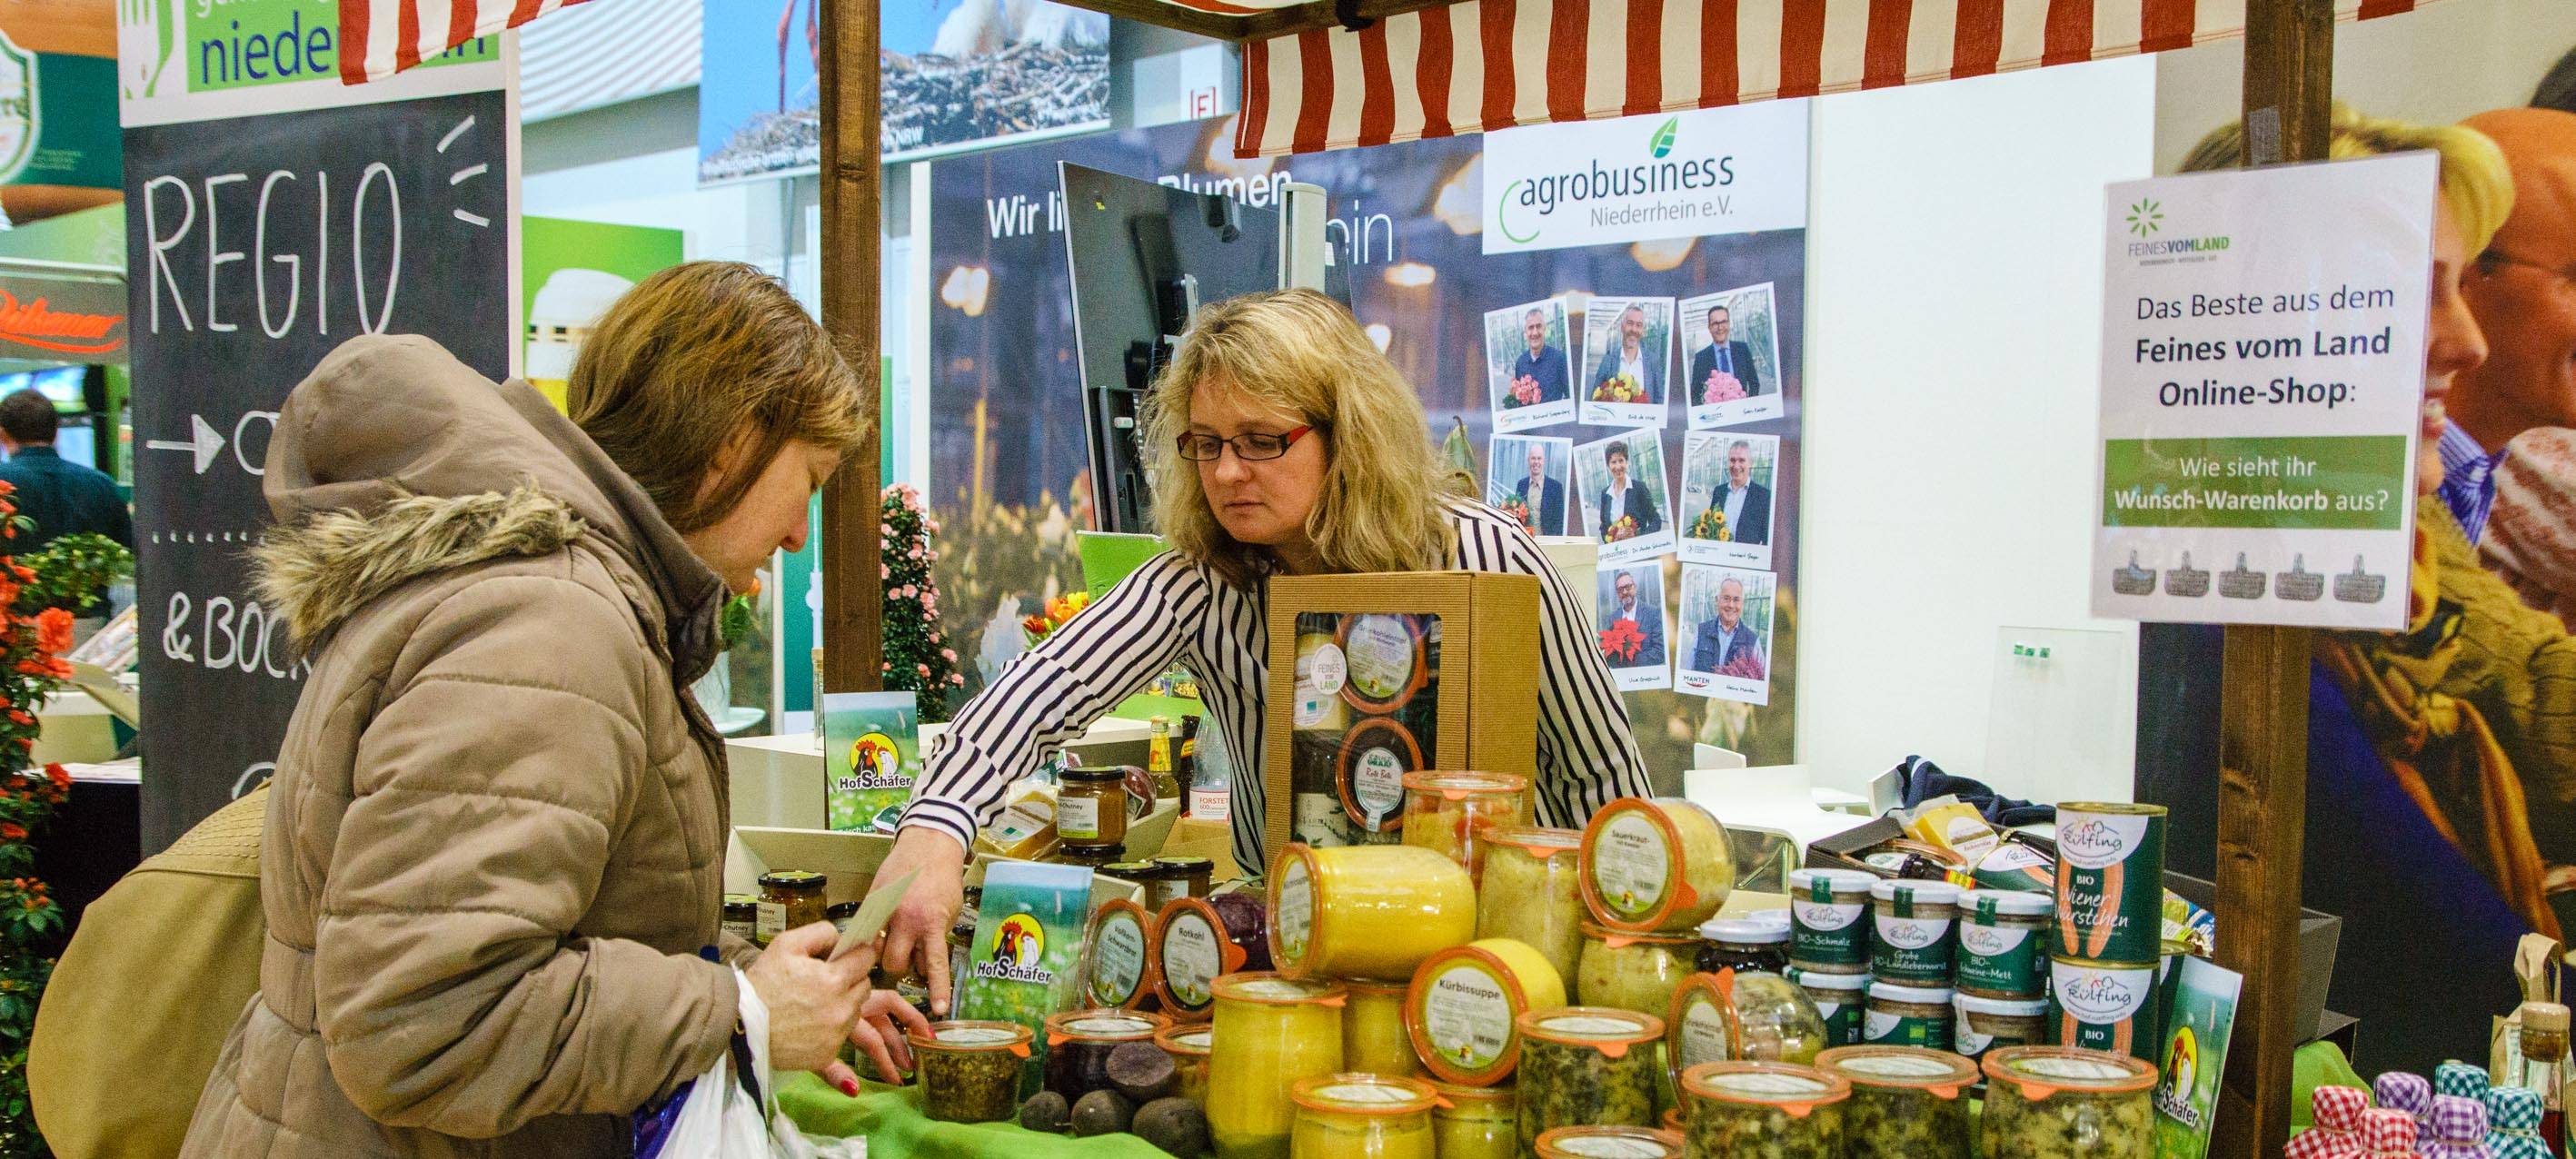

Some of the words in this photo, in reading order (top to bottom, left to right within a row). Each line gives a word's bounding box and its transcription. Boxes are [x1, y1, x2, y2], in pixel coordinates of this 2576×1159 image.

[201, 10, 340, 84] niede
[1519, 155, 1735, 215] agrobusiness
[987, 194, 1039, 239] Wir
[1590, 199, 1696, 227] Niederrhein
[1701, 194, 1733, 217] e.V.
[144, 162, 402, 339] REGIO
[2128, 236, 2230, 256] FEINESVOMLAND
[2136, 296, 2182, 321] Das
[2191, 292, 2263, 318] Beste
[2273, 288, 2320, 313] aus
[2330, 282, 2394, 310] dem
[2136, 336, 2226, 364] Feines
[2235, 336, 2302, 360] vom
[2313, 327, 2392, 357] Land
[2158, 378, 2357, 410] Online-Shop:
[2180, 457, 2222, 478] Wie
[2226, 456, 2280, 478] sieht
[2285, 455, 2317, 477] ihr
[2114, 489, 2328, 511] Wunsch-Warenkorb
[2334, 489, 2390, 512] aus?
[1597, 548, 1629, 561] grobusiness
[1318, 663, 1340, 674] FEINES
[1683, 675, 1710, 684] MANTEN
[1319, 679, 1338, 690] LAND
[839, 770, 911, 790] HofSchäfer
[2064, 829, 2123, 851] Rülfing
[2076, 875, 2094, 886] BIO
[2059, 885, 2112, 907] Wiener
[1178, 926, 1205, 940] Rotkohl
[977, 957, 1052, 984] HofSchäfer
[1438, 979, 1501, 1000] Kürbissuppe
[2067, 986, 2132, 1005] Rülfing
[2084, 1030, 2104, 1041] BIO
[2156, 1085, 2199, 1126] fSchäfer
